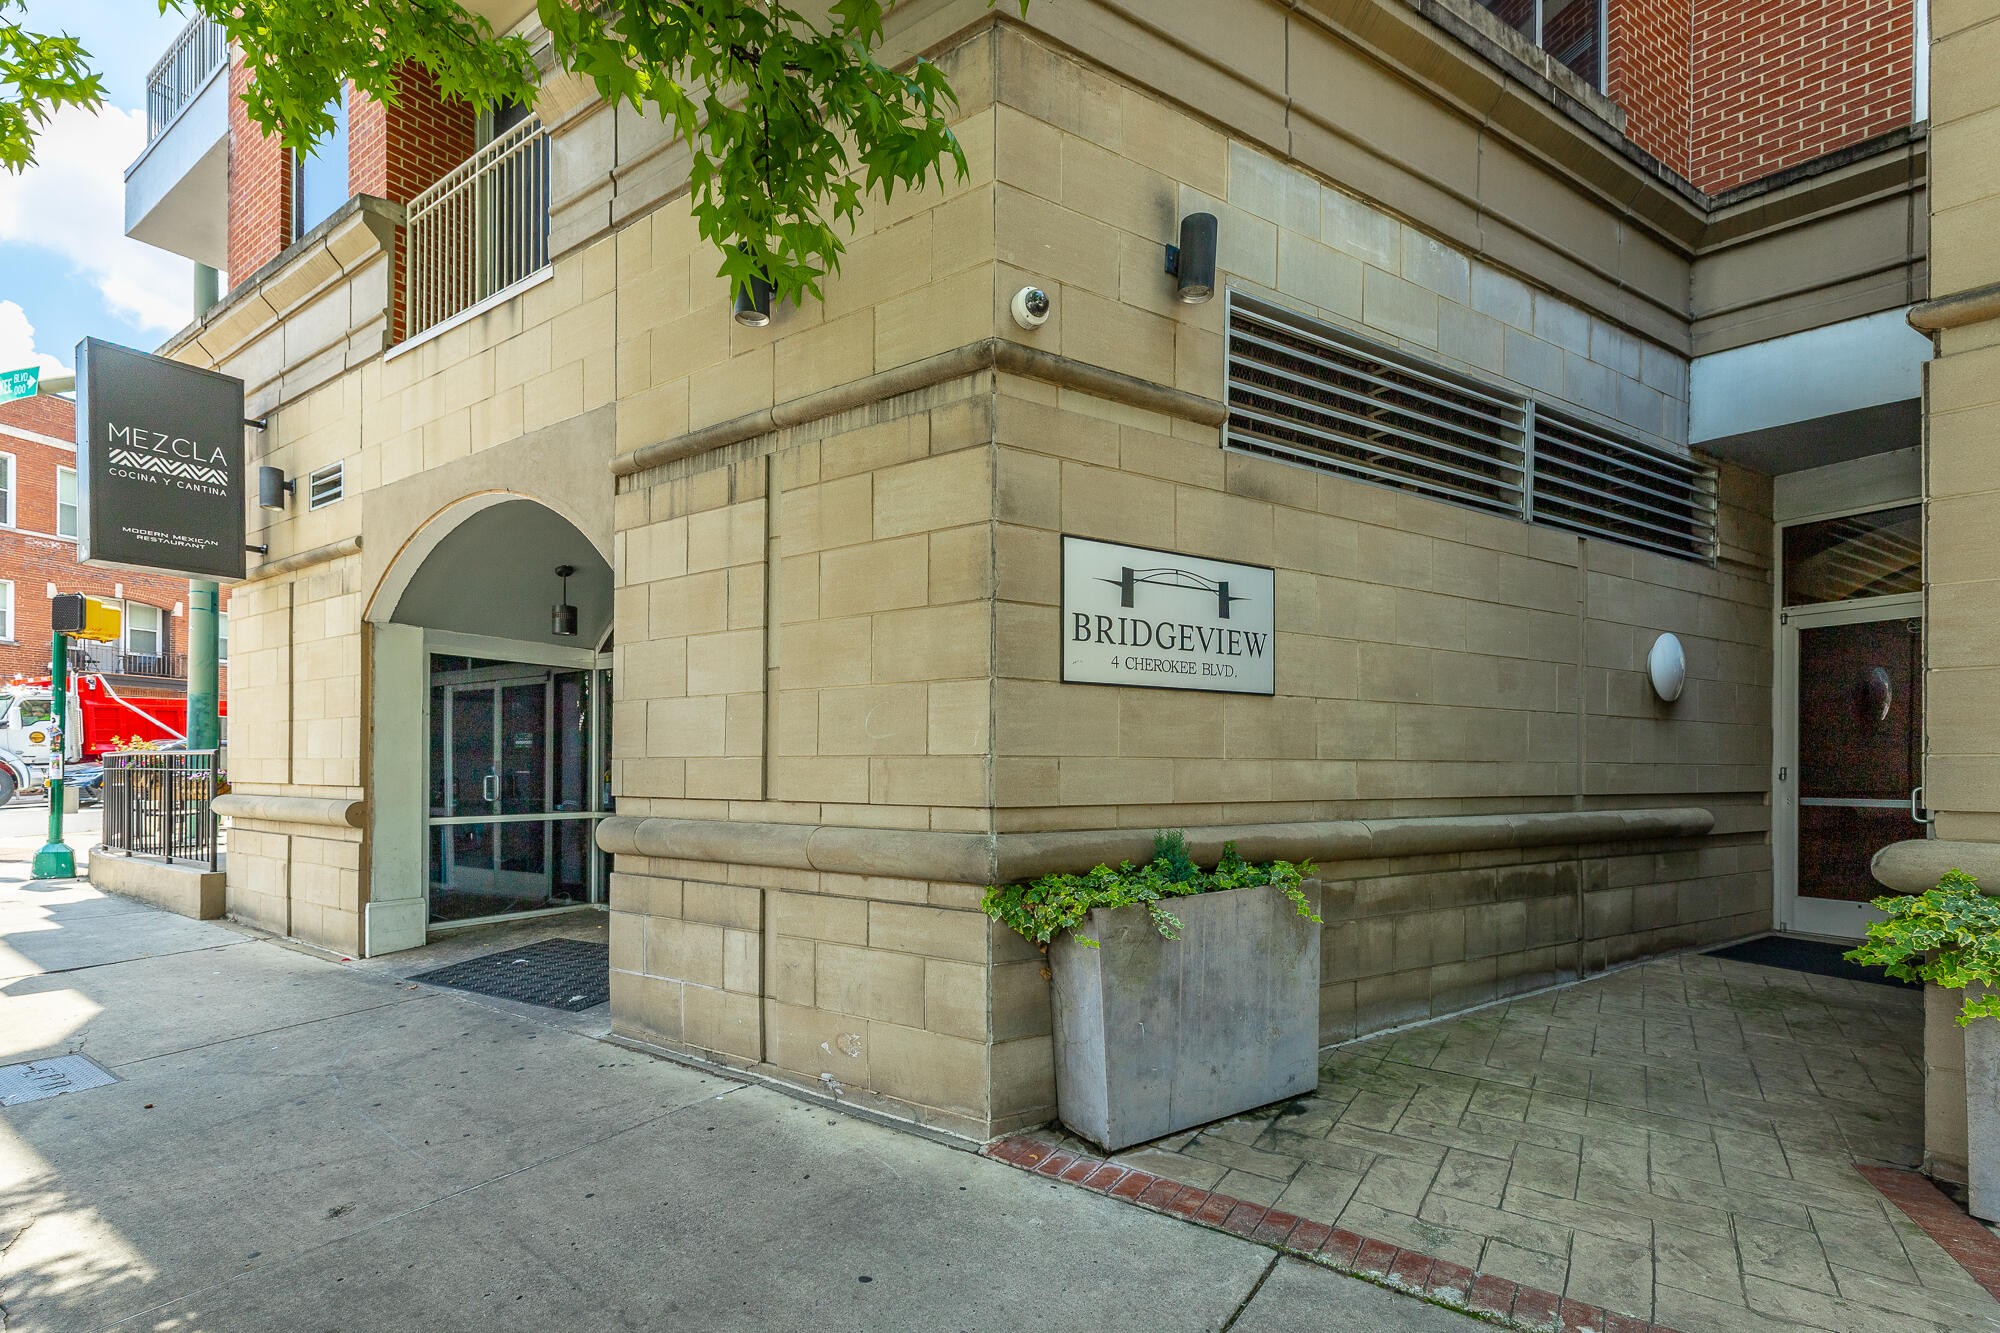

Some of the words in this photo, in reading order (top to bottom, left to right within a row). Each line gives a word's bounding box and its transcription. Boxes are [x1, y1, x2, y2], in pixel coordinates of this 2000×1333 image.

[108, 422, 228, 467] MEZCLA
[108, 467, 157, 484] COCINA
[163, 478, 171, 486] Y
[176, 481, 227, 497] CANTINA
[122, 526, 169, 539] MODERN
[172, 534, 219, 546] MEXICAN
[136, 534, 206, 550] RESTAURANT
[1072, 612, 1267, 659] BRIDGEVIEW
[1111, 656, 1119, 668] 4
[1125, 656, 1197, 675] CHEROKEE
[1202, 662, 1238, 678] BLVD.
